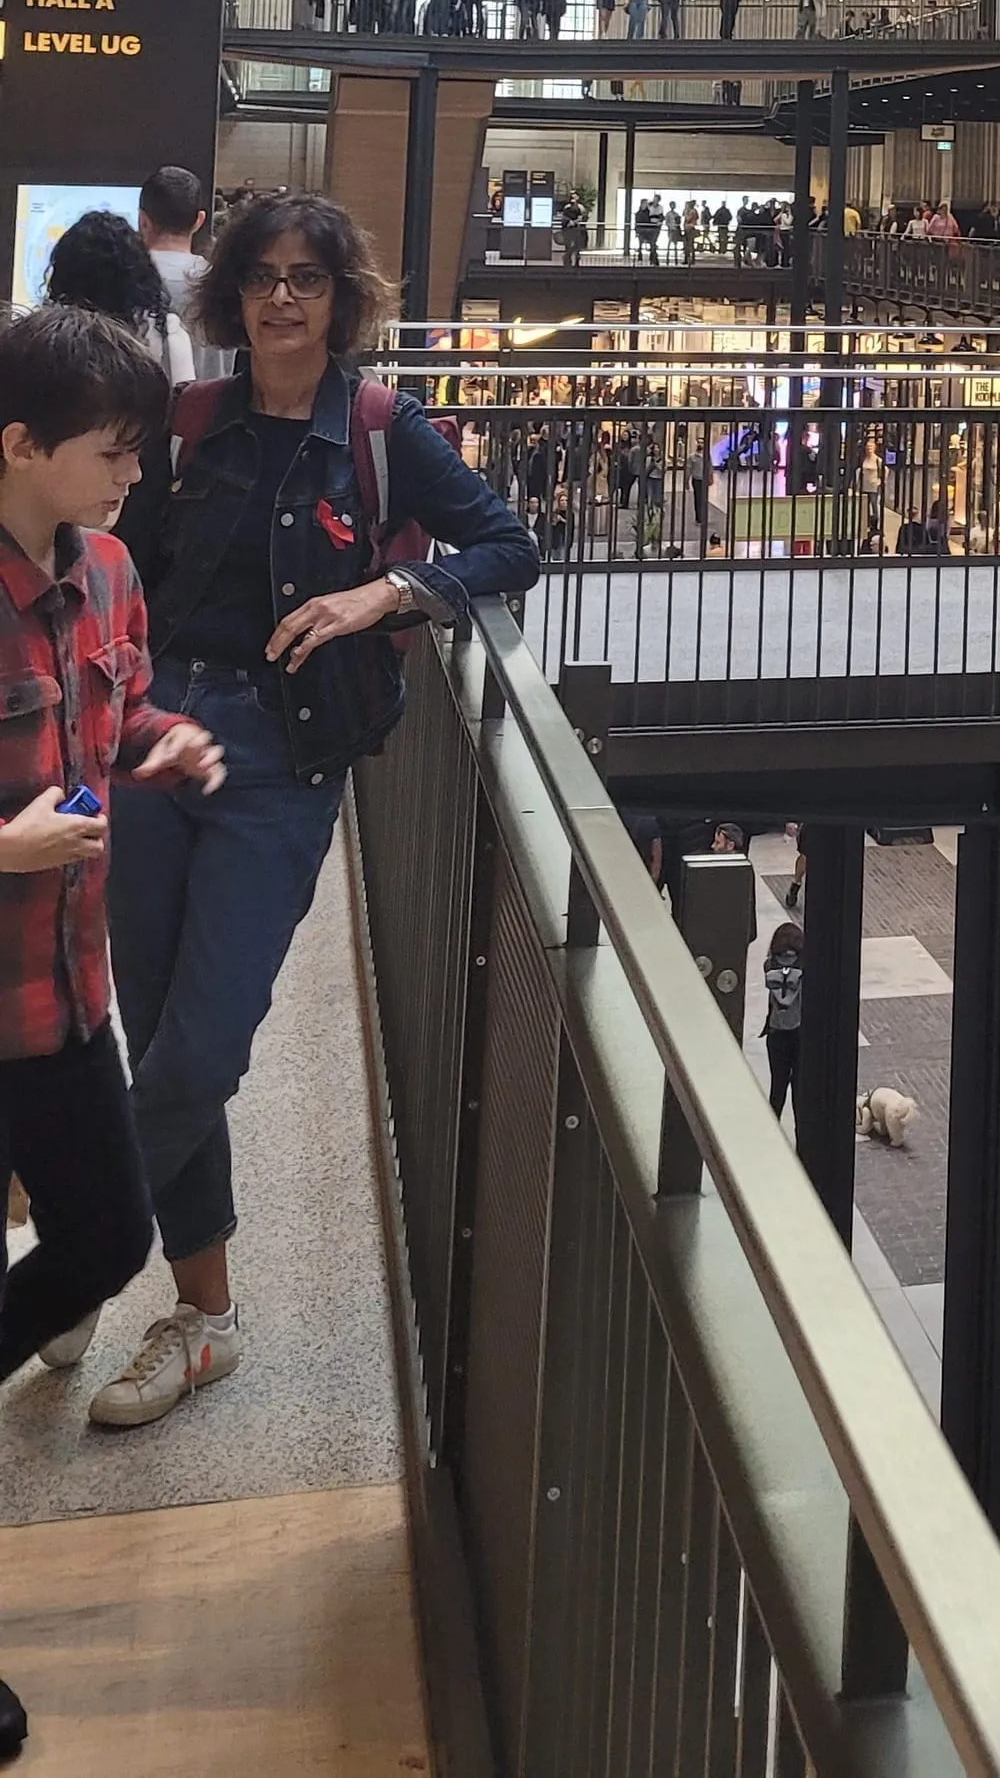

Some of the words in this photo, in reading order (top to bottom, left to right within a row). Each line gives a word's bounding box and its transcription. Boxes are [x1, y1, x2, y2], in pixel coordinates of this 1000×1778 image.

[24, 32, 97, 53] LEVEL
[101, 35, 141, 55] UG
[976, 381, 990, 391] THE
